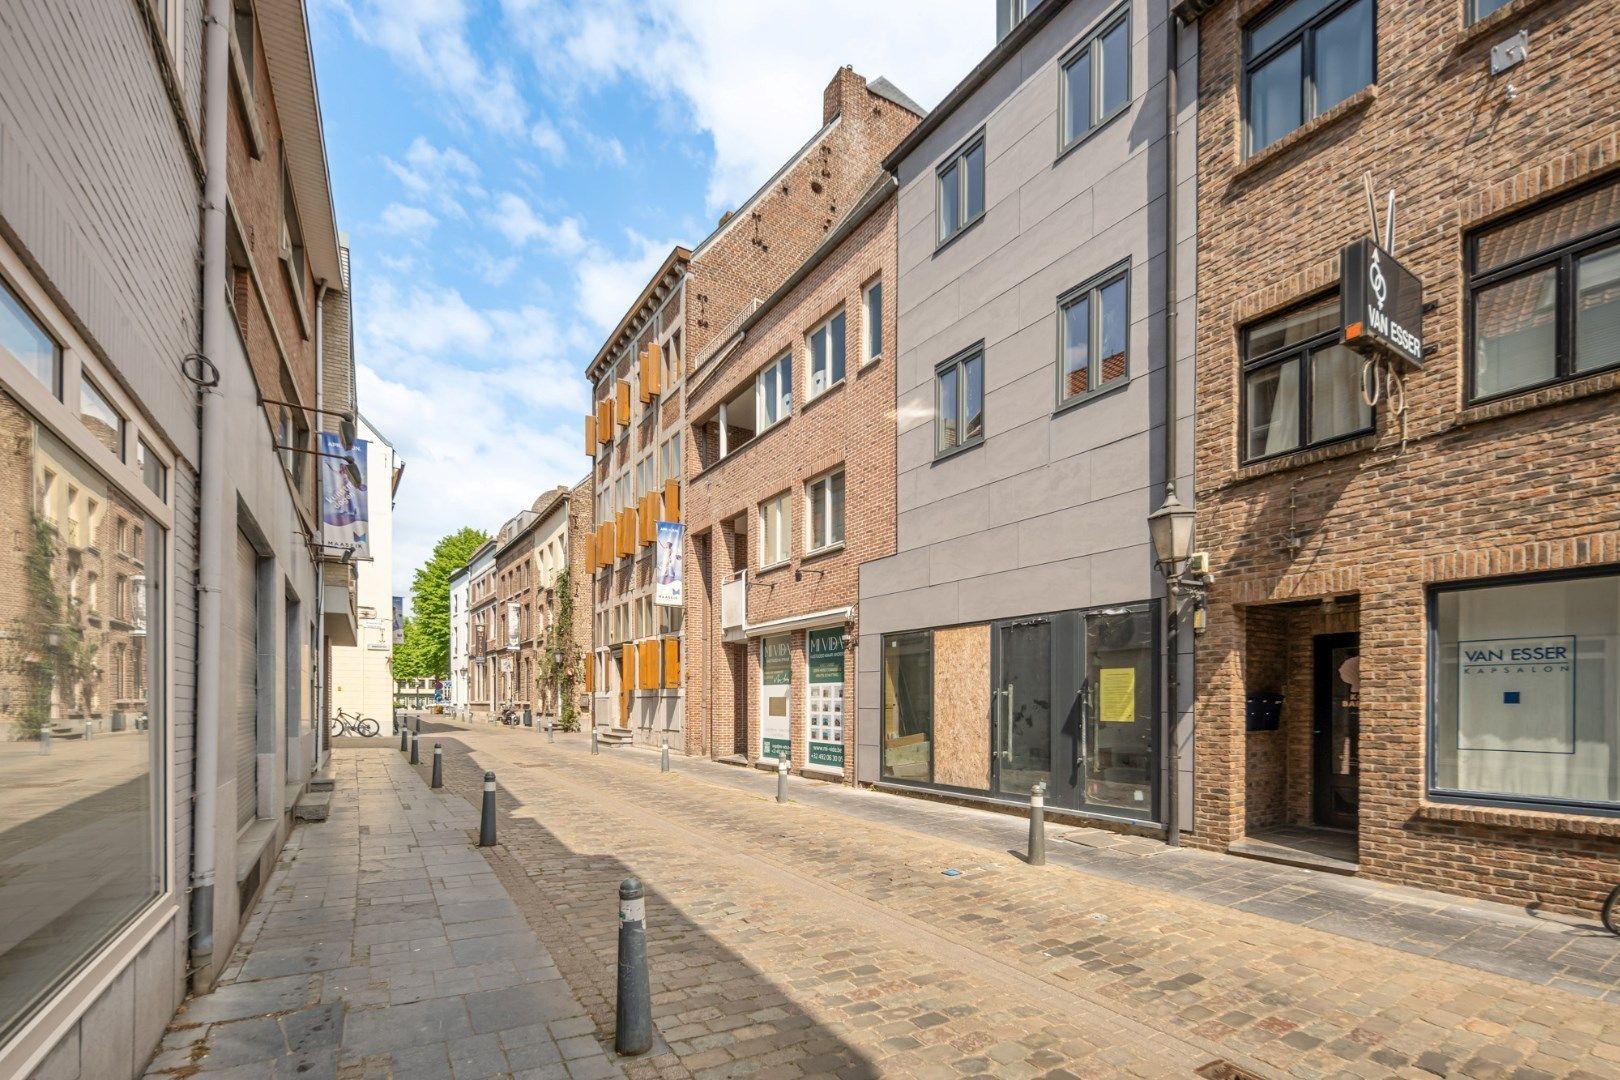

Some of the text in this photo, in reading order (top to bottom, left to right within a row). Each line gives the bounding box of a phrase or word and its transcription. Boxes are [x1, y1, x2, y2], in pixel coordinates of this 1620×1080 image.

[1368, 304, 1421, 358] VAN ESSER
[1464, 646, 1567, 662] VAN ESSER
[1463, 665, 1570, 675] KAPSALON
